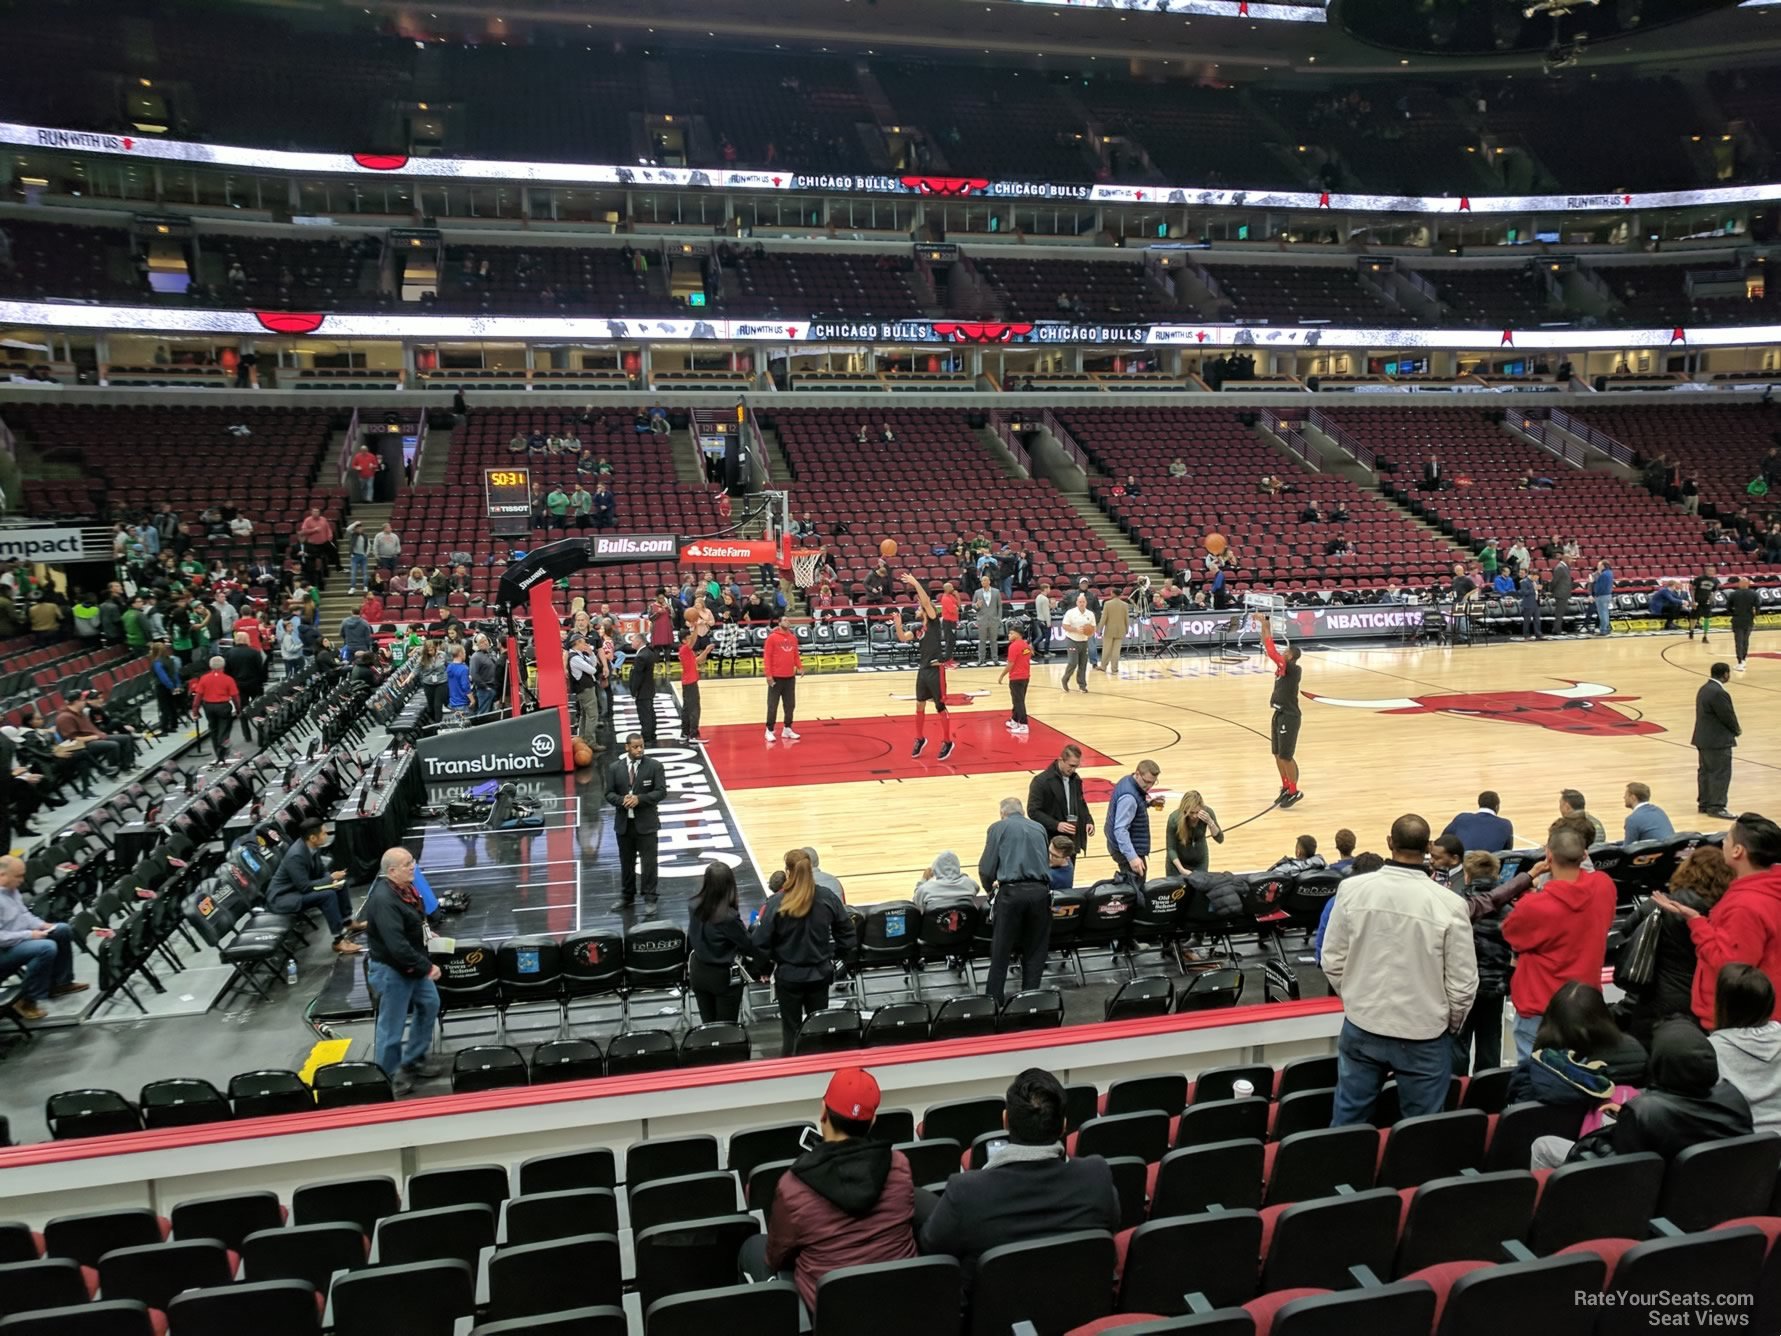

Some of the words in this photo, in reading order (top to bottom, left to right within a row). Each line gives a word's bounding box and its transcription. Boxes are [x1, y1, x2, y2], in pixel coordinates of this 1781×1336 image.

[38, 129, 69, 146] RUN
[70, 133, 100, 147] WITH
[102, 136, 119, 149] US
[798, 176, 851, 188] CHICAGO
[857, 178, 895, 189] BULLS
[994, 183, 1046, 195] CHICAGO
[1051, 186, 1086, 197] BULLS
[739, 325, 756, 335] RUN
[757, 326, 773, 334] WITH
[774, 326, 783, 334] US
[816, 325, 877, 337] CHICAGO
[883, 326, 926, 338] BULLS
[1039, 328, 1097, 340] CHICAGO
[1102, 329, 1142, 341] BULLS
[1155, 332, 1169, 341] RUN
[598, 539, 672, 553] Bulls.com
[797, 626, 809, 638] G
[817, 626, 828, 638] G
[837, 625, 848, 637] G
[1181, 619, 1214, 635] FOR
